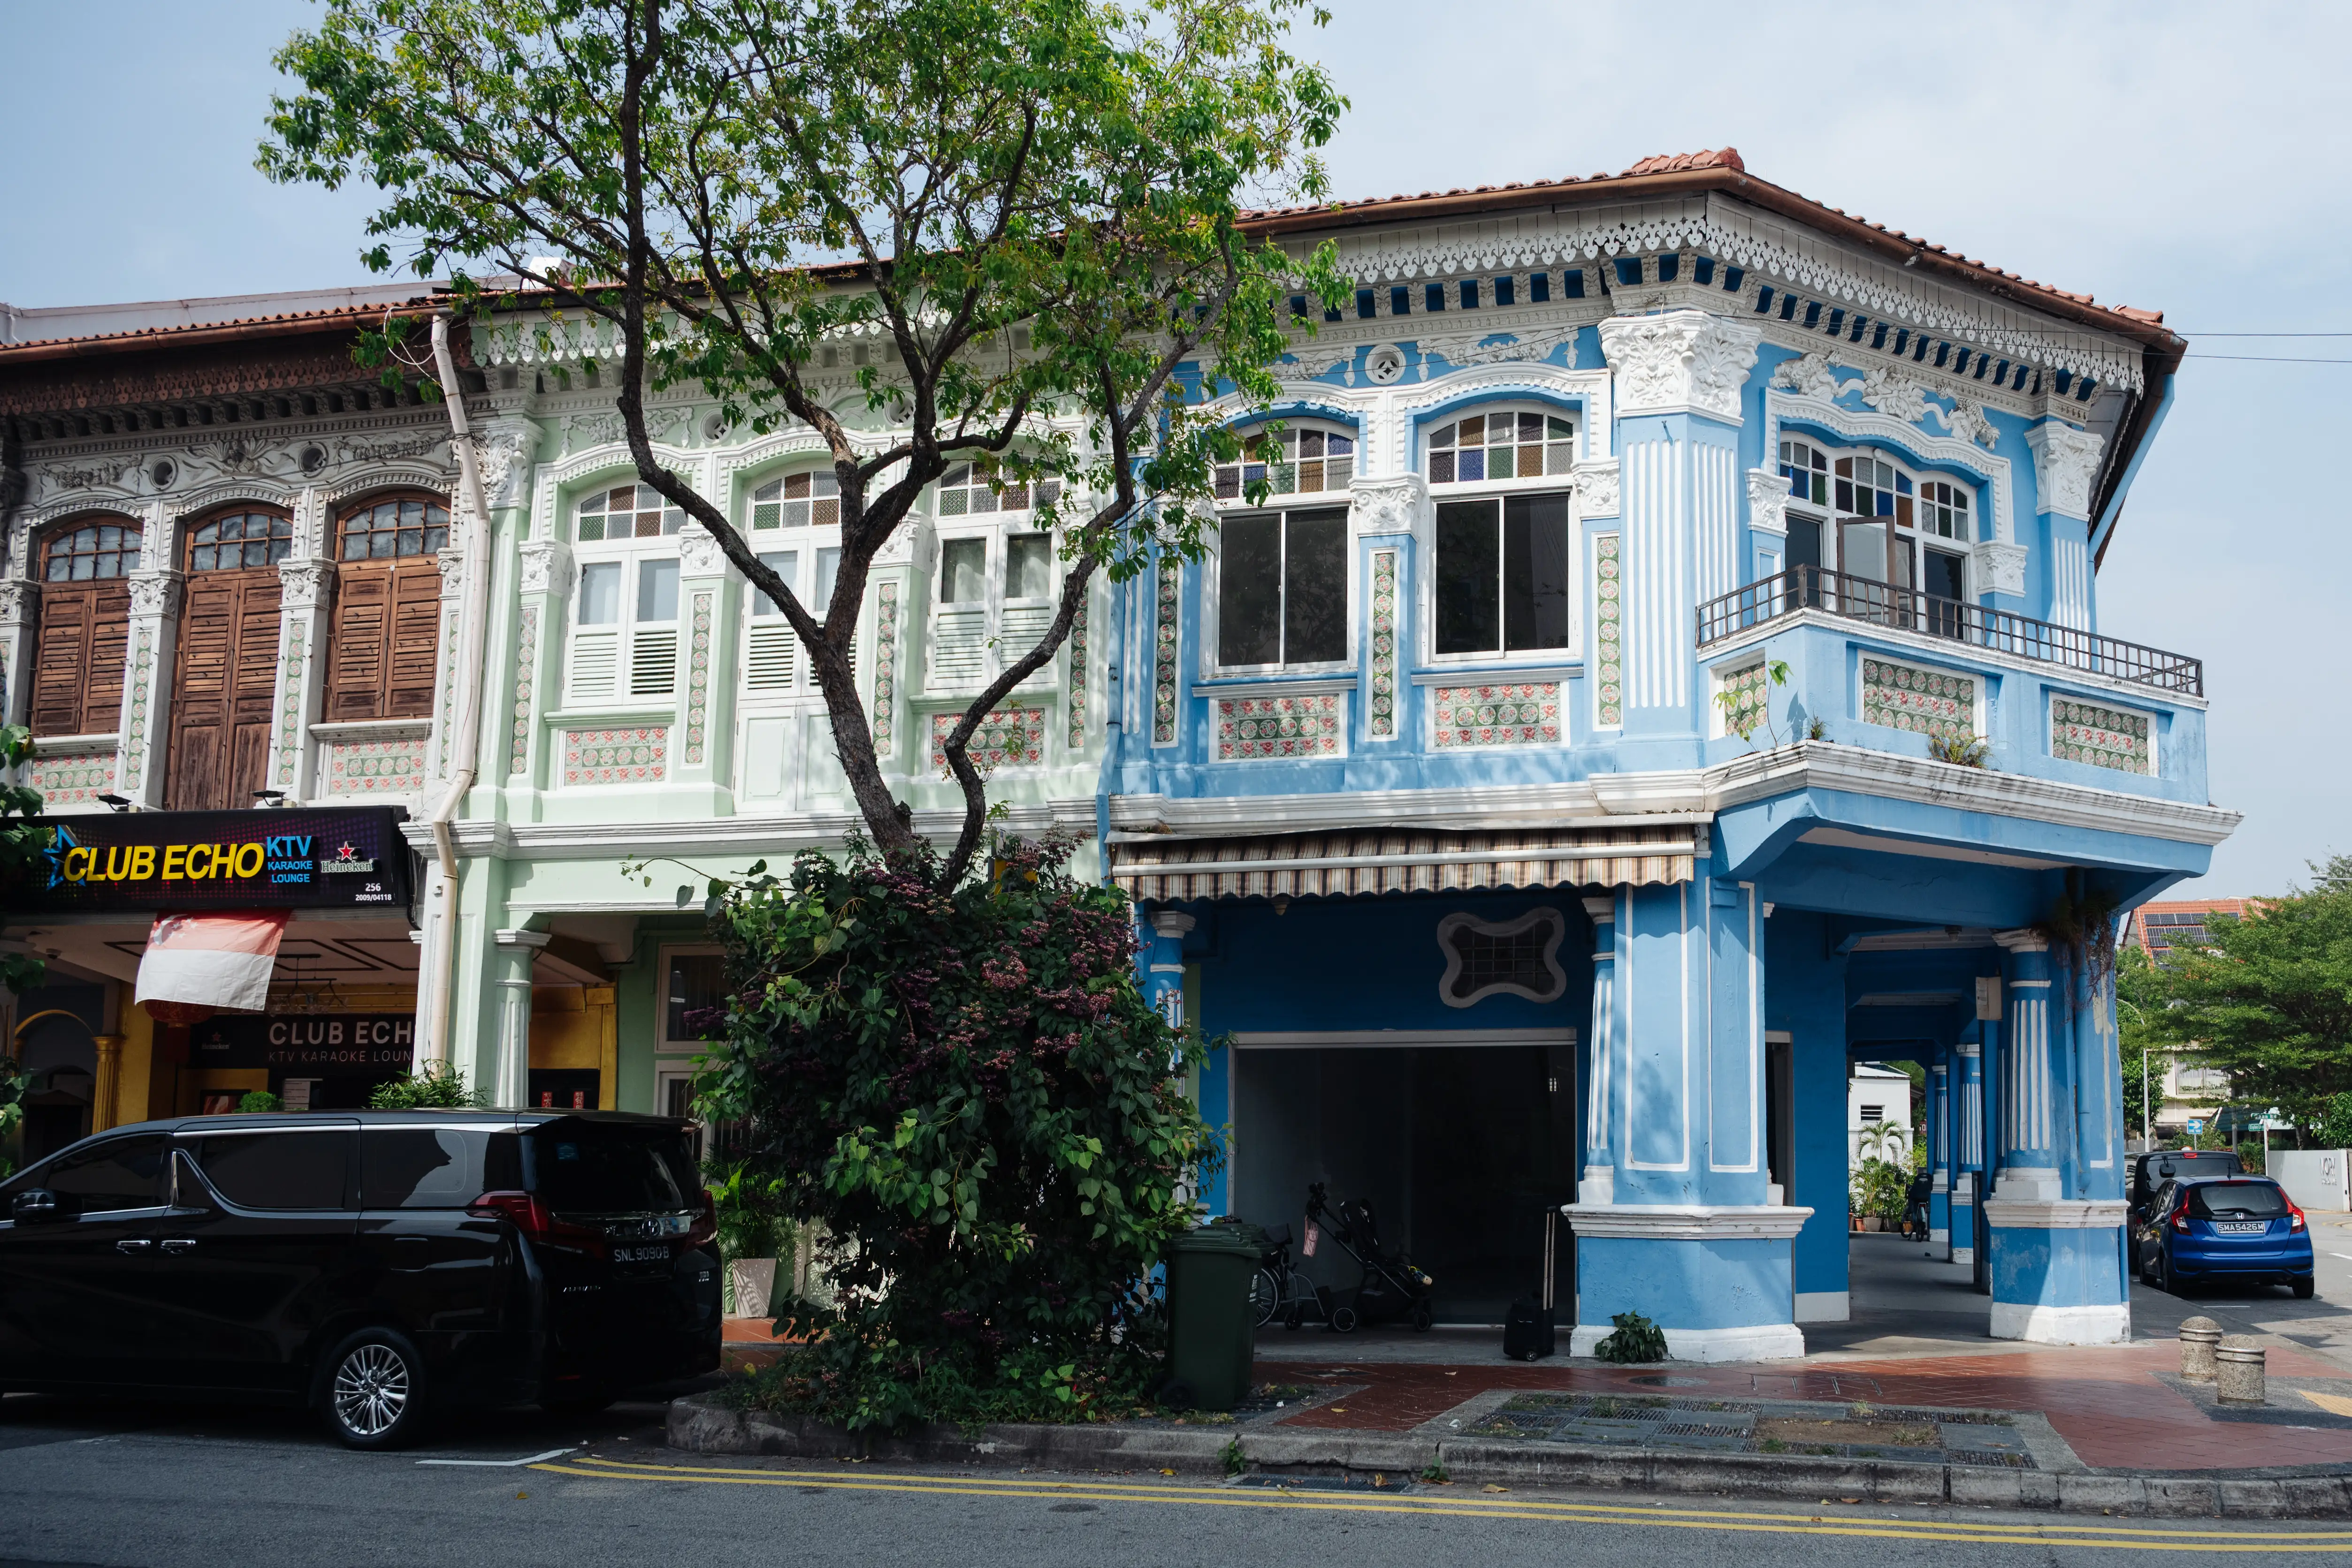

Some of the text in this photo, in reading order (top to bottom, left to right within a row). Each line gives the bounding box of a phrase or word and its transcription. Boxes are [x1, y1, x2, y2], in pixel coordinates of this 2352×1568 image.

[267, 835, 312, 857] KTV
[64, 843, 264, 881] CLUB ECHO
[267, 860, 313, 870] KARAOKE
[321, 859, 373, 873] Heineken
[271, 873, 310, 883] LOUNGE
[365, 883, 381, 892] 256
[269, 1021, 412, 1045] CLUB ECH
[269, 1050, 412, 1062] KTV KARAOKE LOUN
